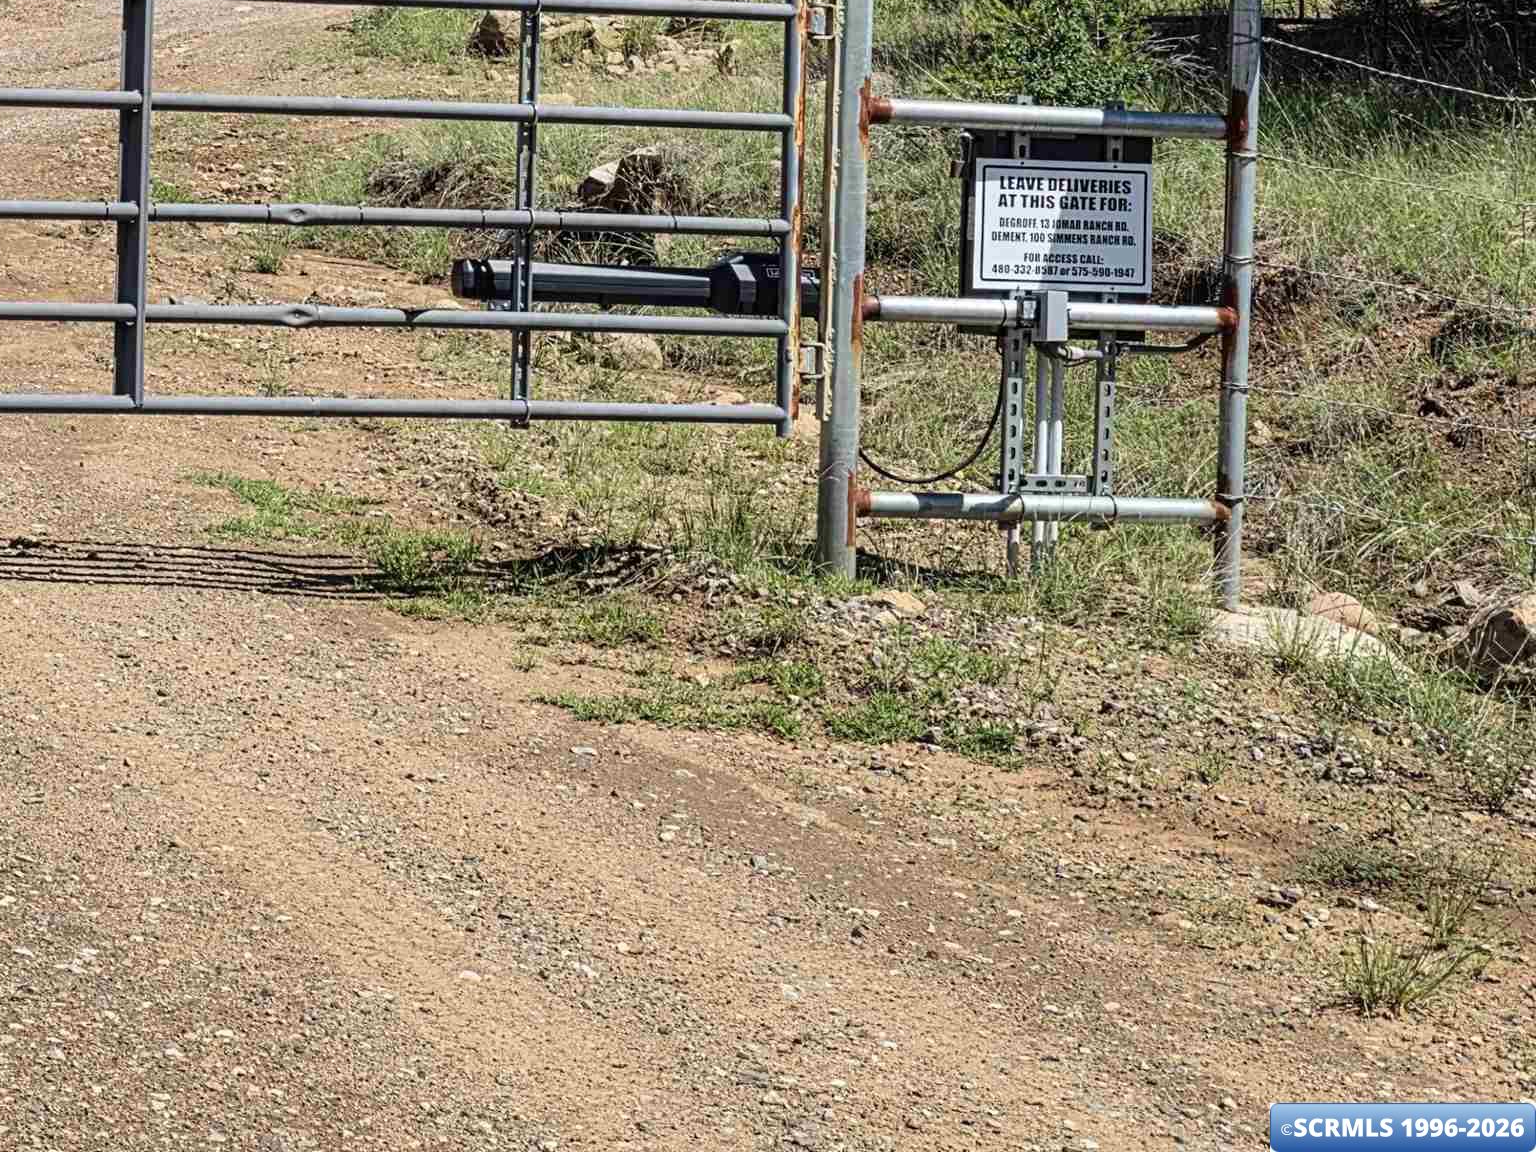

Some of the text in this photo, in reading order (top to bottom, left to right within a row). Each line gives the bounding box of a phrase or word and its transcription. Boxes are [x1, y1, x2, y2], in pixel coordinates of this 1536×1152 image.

[1000, 176, 1132, 194] LEAVE DELIVERIES
[998, 194, 1133, 212] AT THIS GATE FOR:
[1040, 219, 1050, 229] 13
[1052, 219, 1081, 230] JOMAR
[1083, 220, 1113, 231] RANCH
[1115, 221, 1129, 232] RD.
[1030, 232, 1046, 242] 100
[1047, 233, 1088, 244] SIMMENS
[1090, 234, 1120, 245] RANCH
[1122, 235, 1136, 246] RD.
[1024, 253, 1104, 265] FOR ACCESS CALL:
[1060, 268, 1070, 276] or
